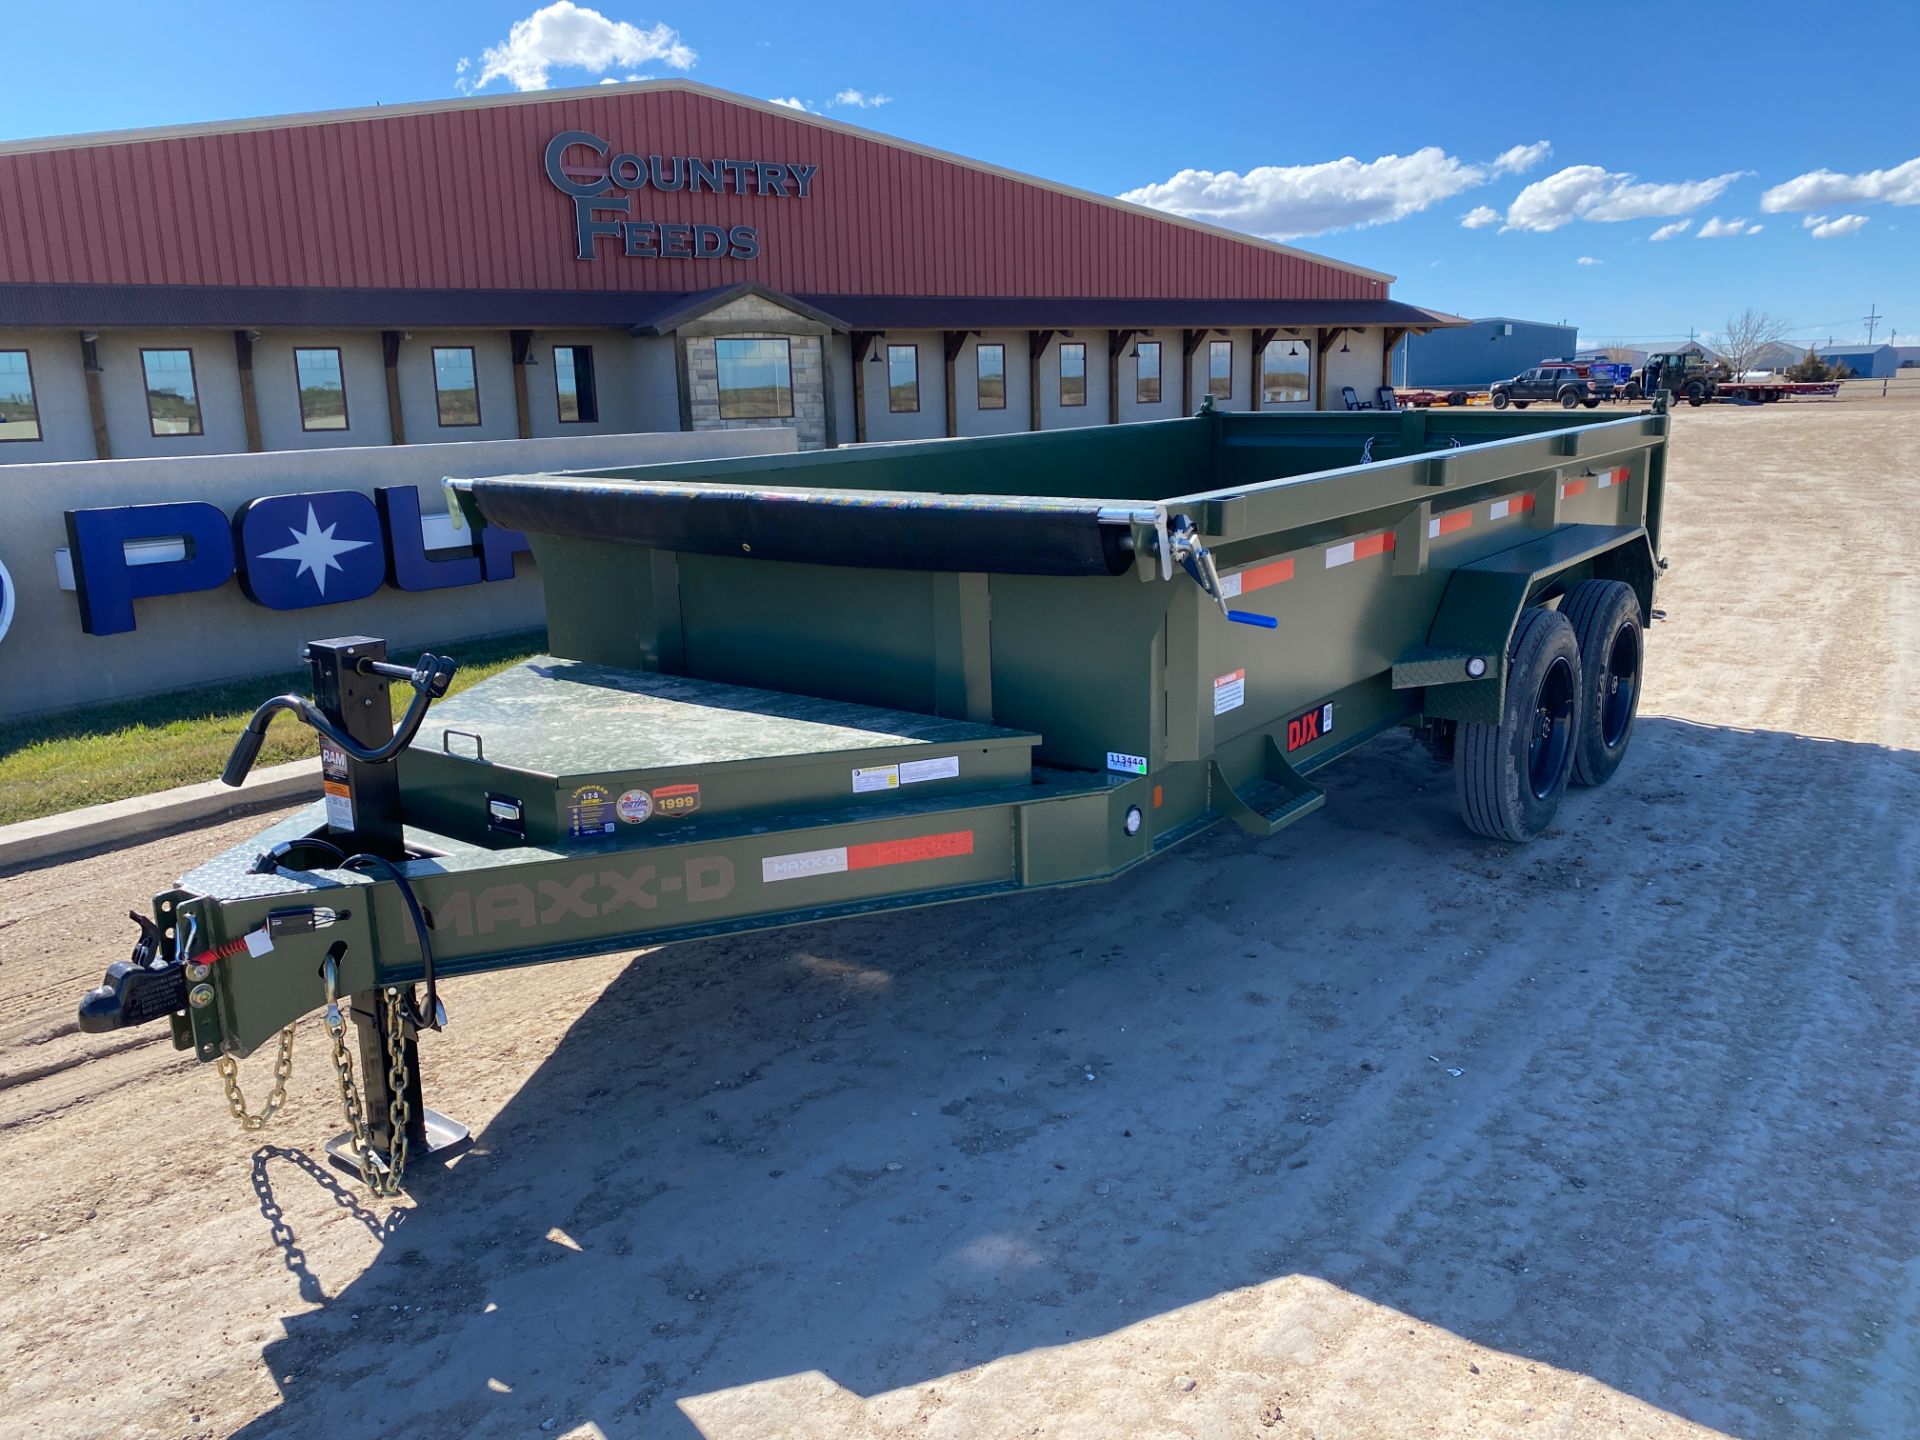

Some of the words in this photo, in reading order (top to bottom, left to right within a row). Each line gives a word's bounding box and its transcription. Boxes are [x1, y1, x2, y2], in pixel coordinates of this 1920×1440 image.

[545, 130, 819, 198] COUNTRY
[572, 195, 760, 260] FEEDS
[1288, 710, 1319, 752] DJX
[323, 749, 345, 766] RAM
[1110, 754, 1143, 765] 113444
[659, 796, 694, 809] 1999
[775, 856, 836, 873] MAXX-D
[402, 855, 736, 944] MAXX-D
